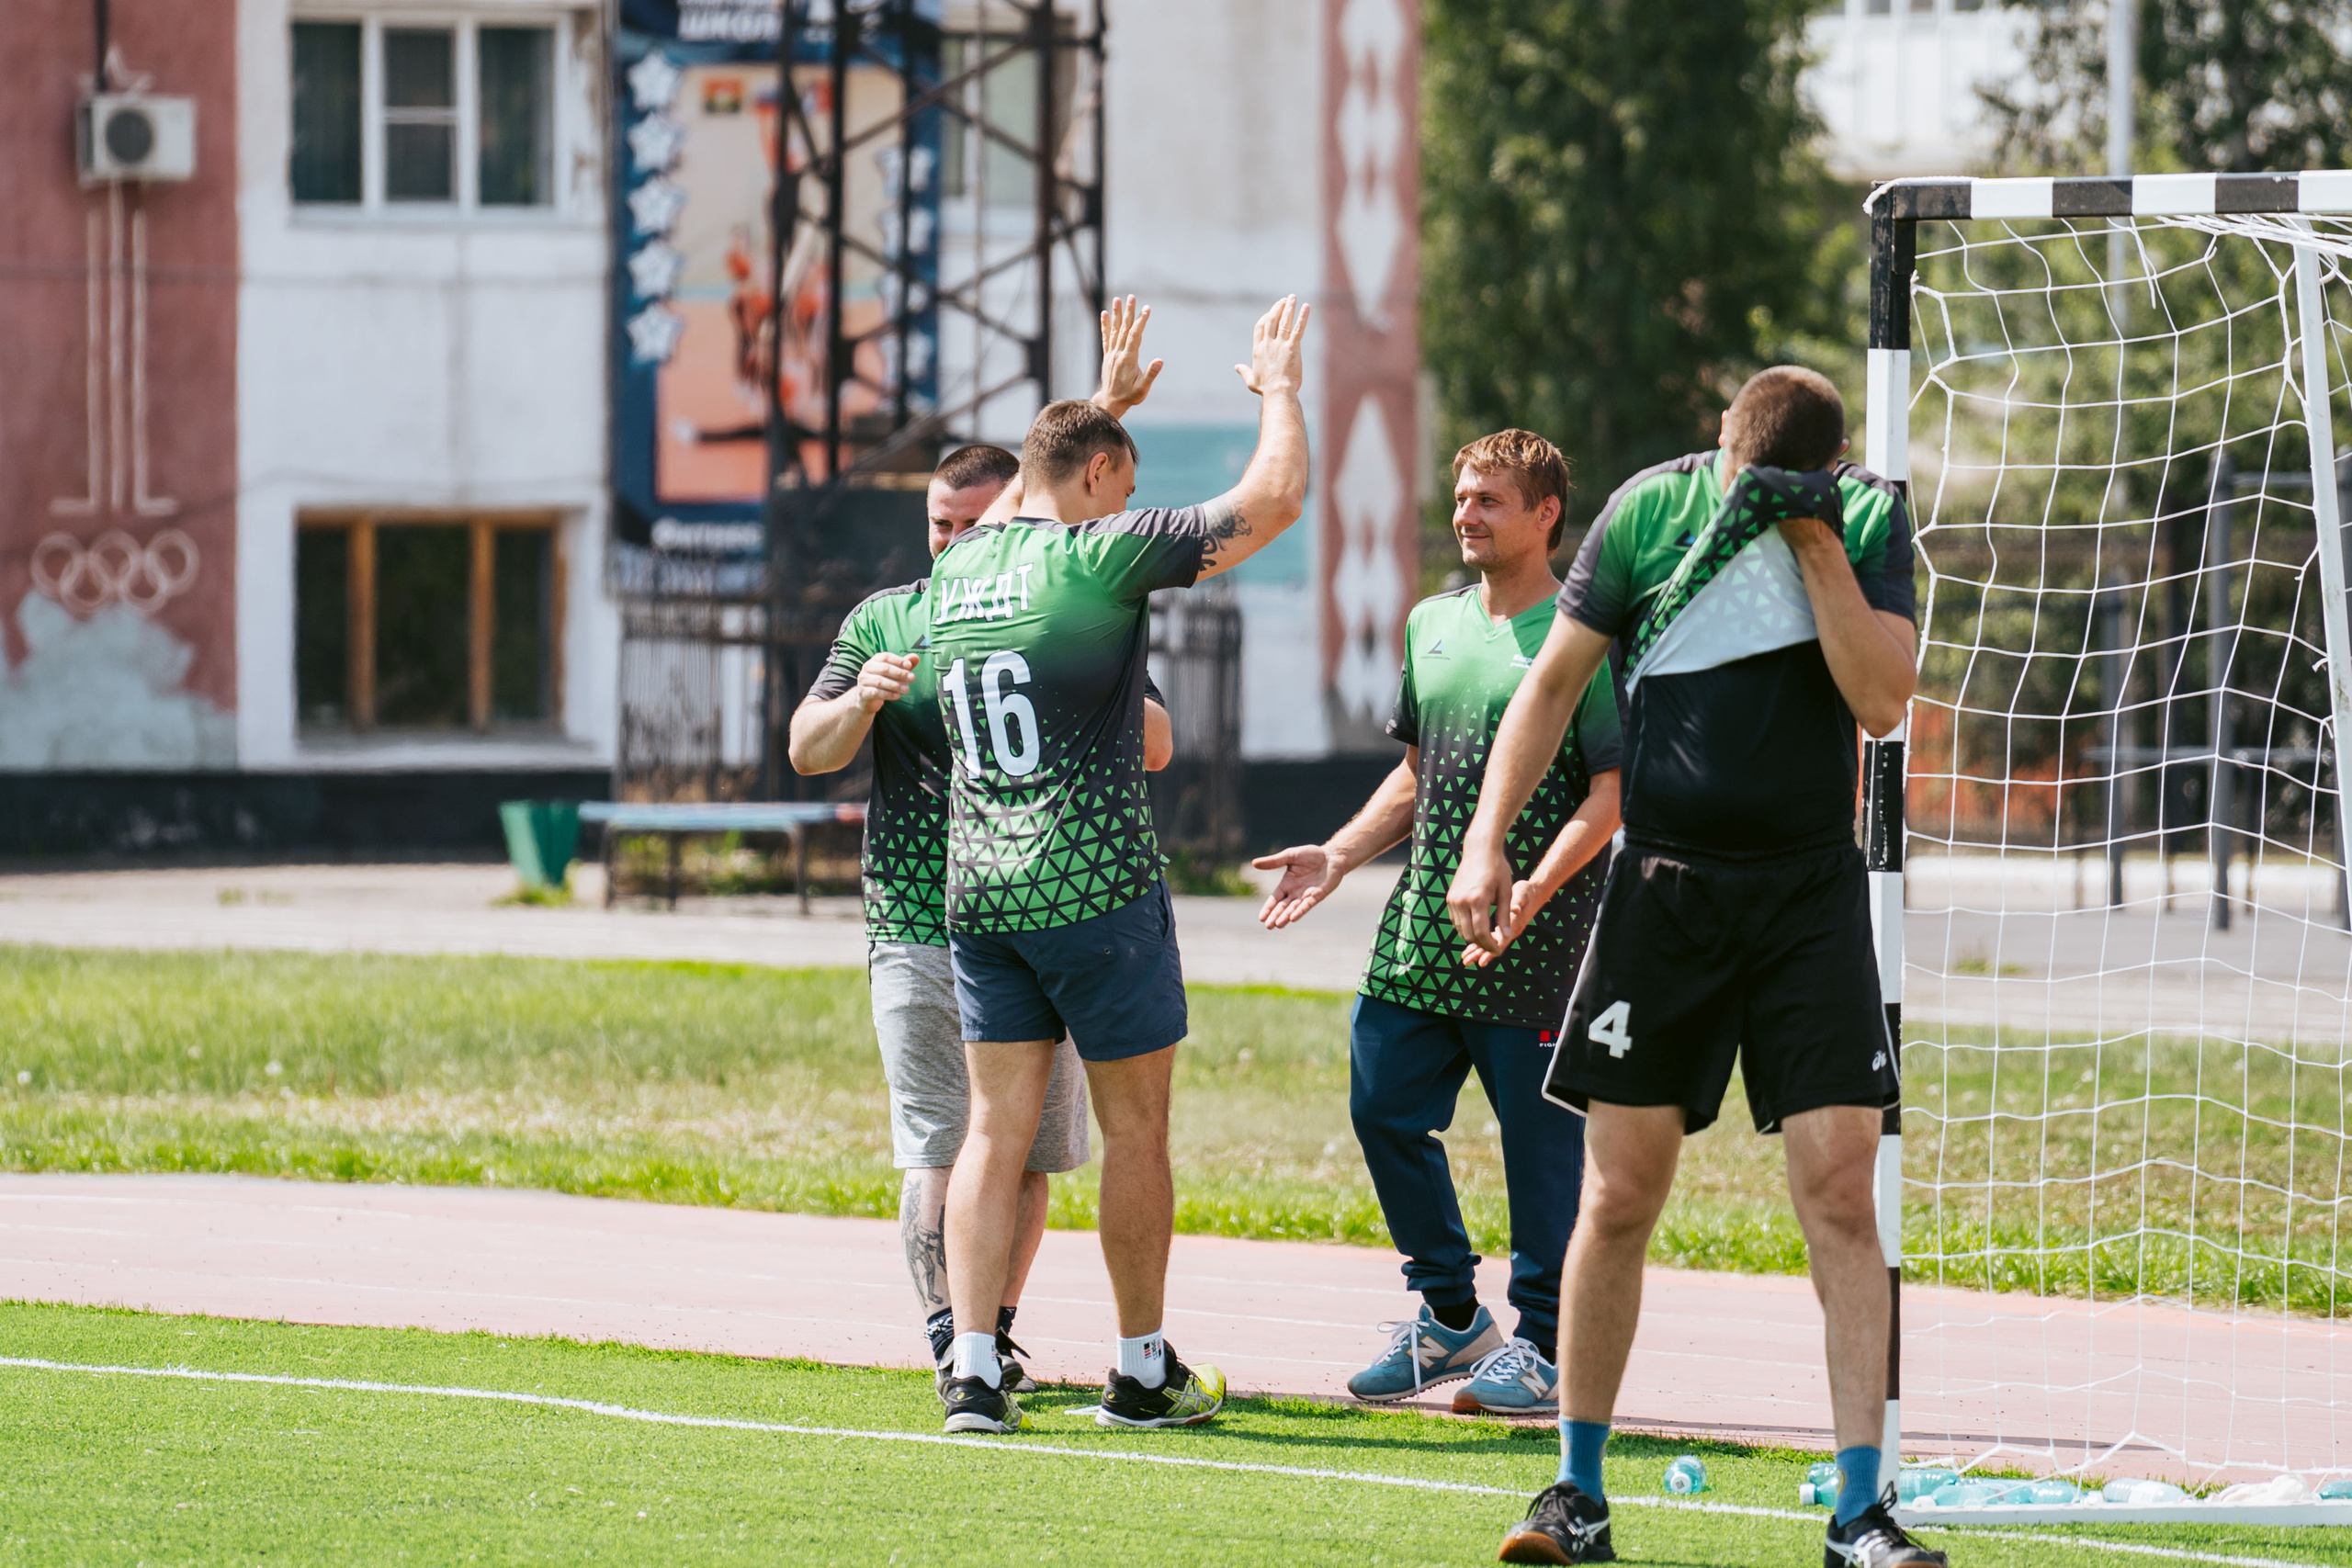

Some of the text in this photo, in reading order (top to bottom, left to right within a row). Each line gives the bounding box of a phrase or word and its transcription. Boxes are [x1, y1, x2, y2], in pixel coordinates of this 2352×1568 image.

[677, 9, 784, 42] ШКОЛ
[934, 562, 1035, 626] УЖДТ
[942, 649, 1040, 780] 16
[1588, 999, 1633, 1059] 4
